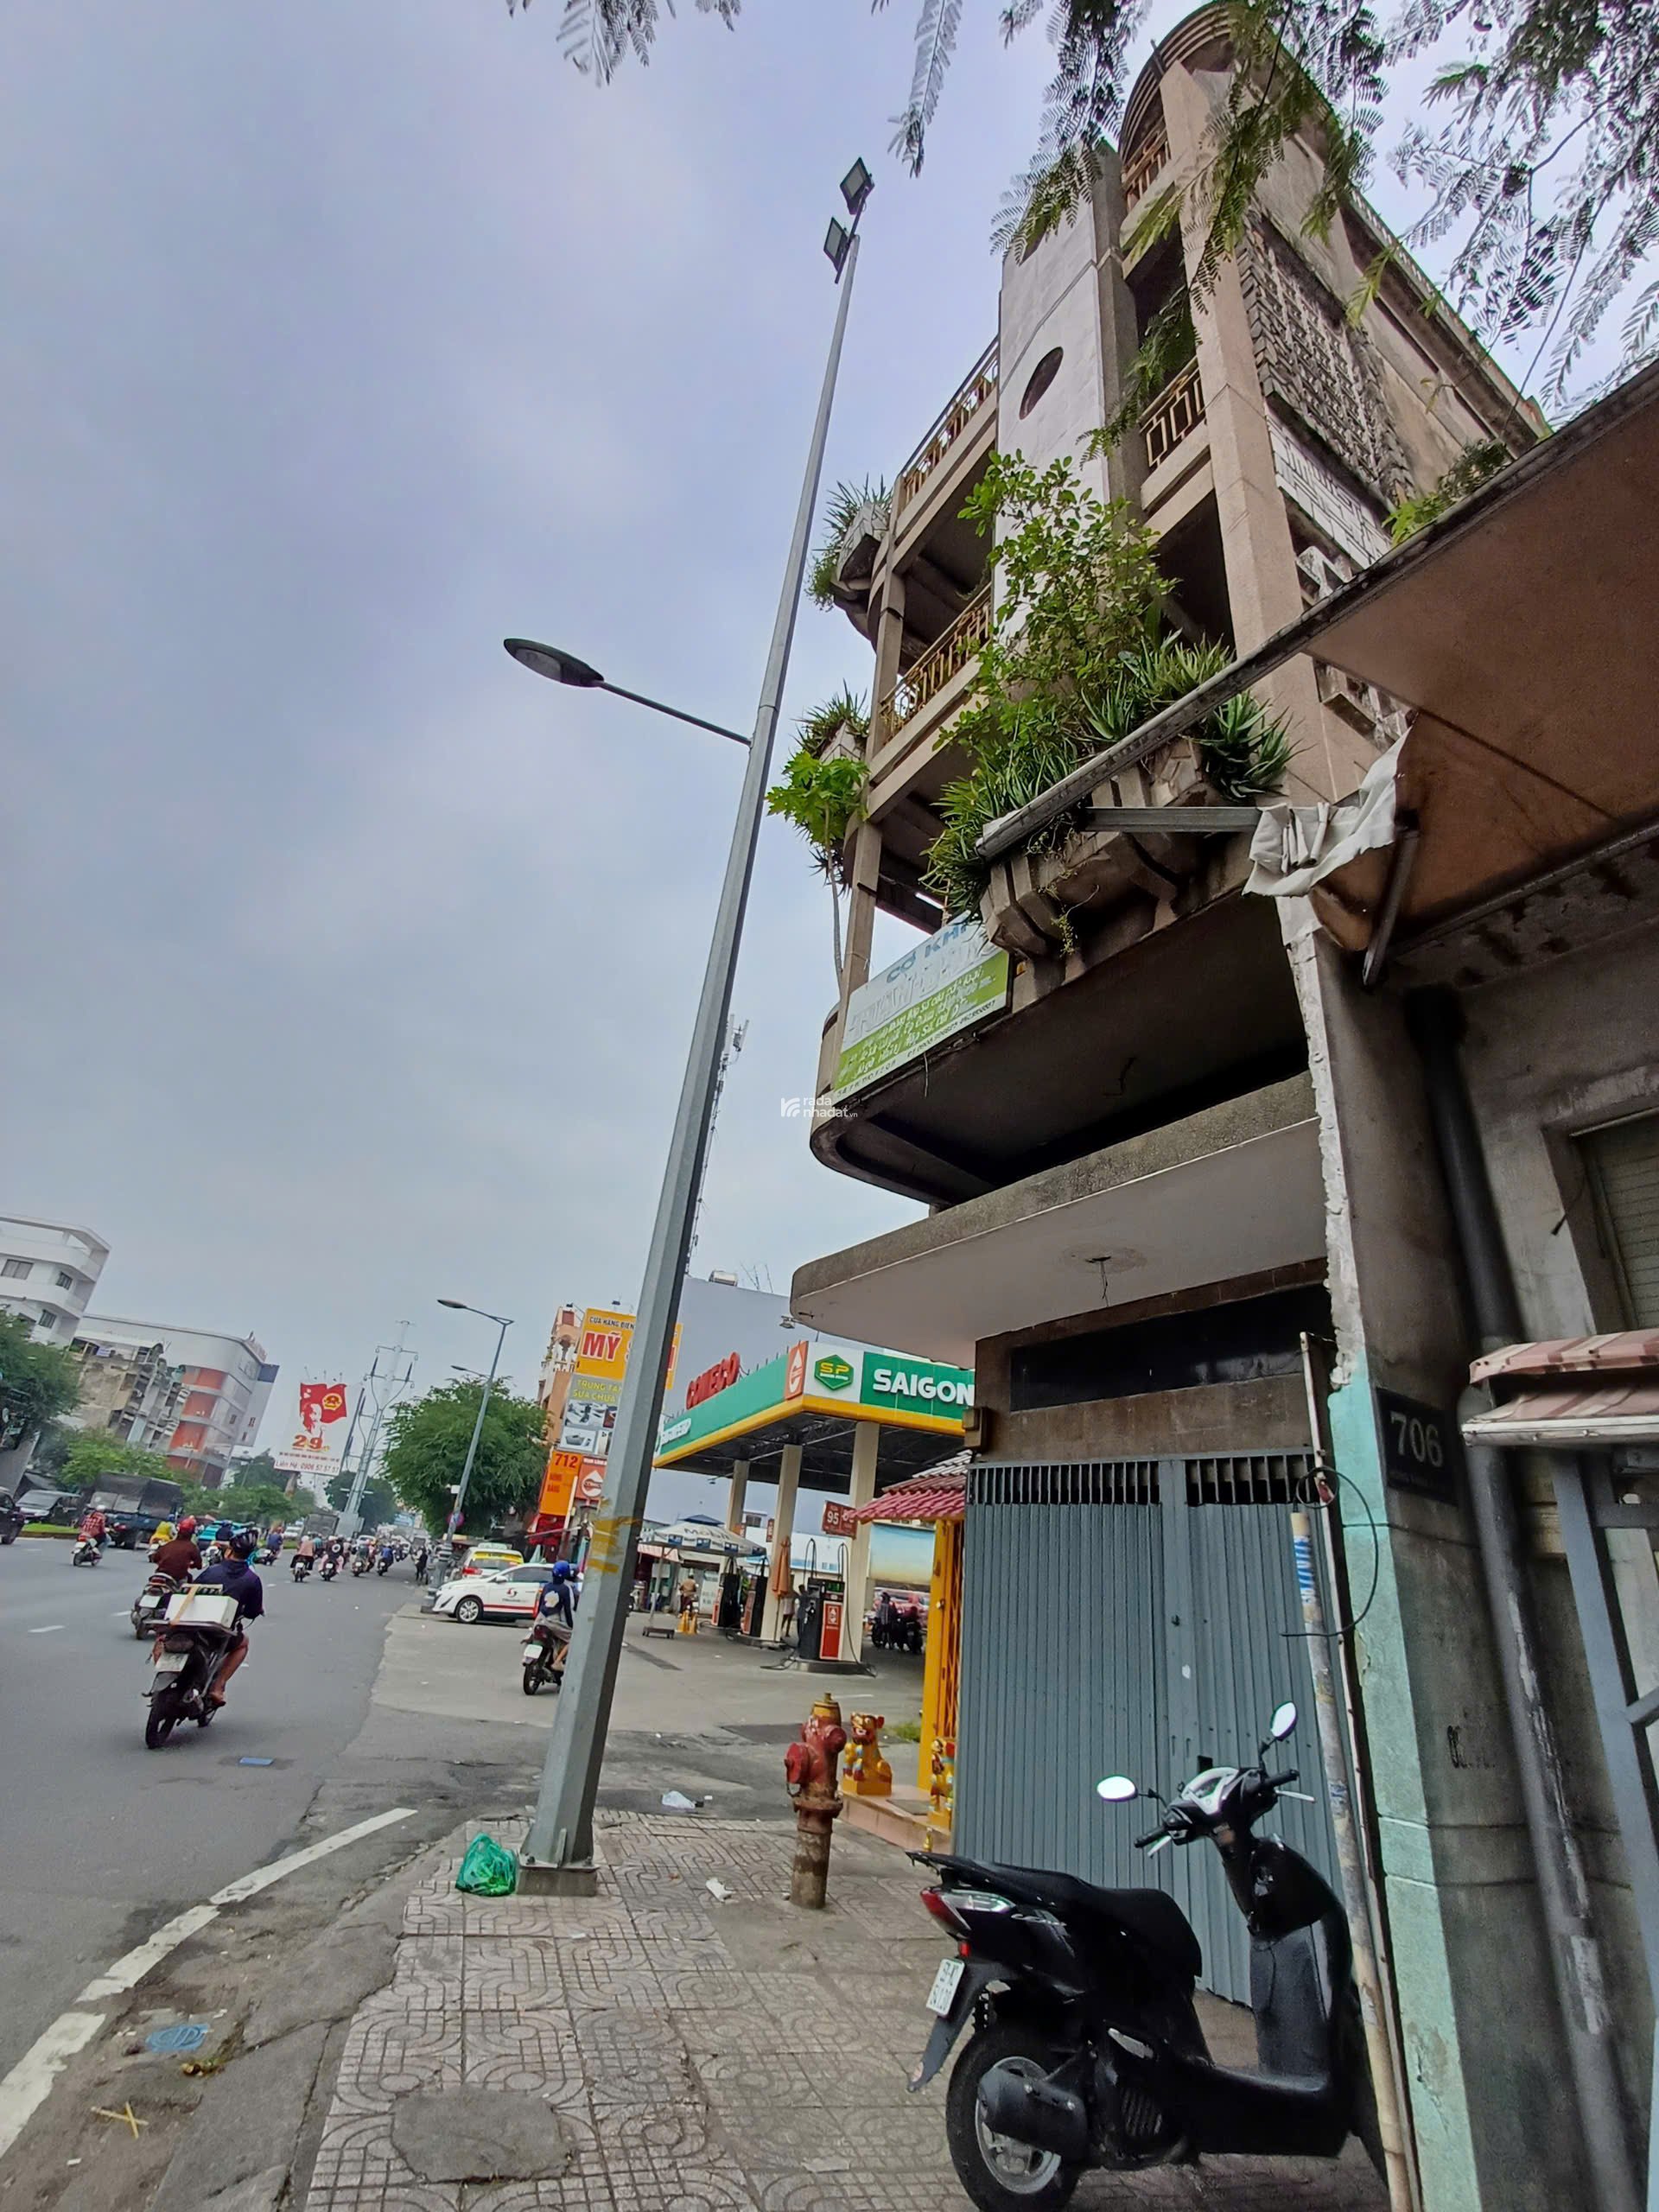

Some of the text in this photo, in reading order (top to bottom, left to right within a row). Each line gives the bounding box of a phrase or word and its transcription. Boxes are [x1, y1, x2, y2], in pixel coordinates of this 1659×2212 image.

[581, 1331, 622, 1362] MỸ
[873, 1368, 976, 1407] SAIGON
[1389, 1410, 1444, 1468] 706
[555, 1453, 579, 1469] 712
[827, 1510, 839, 1525] 95
